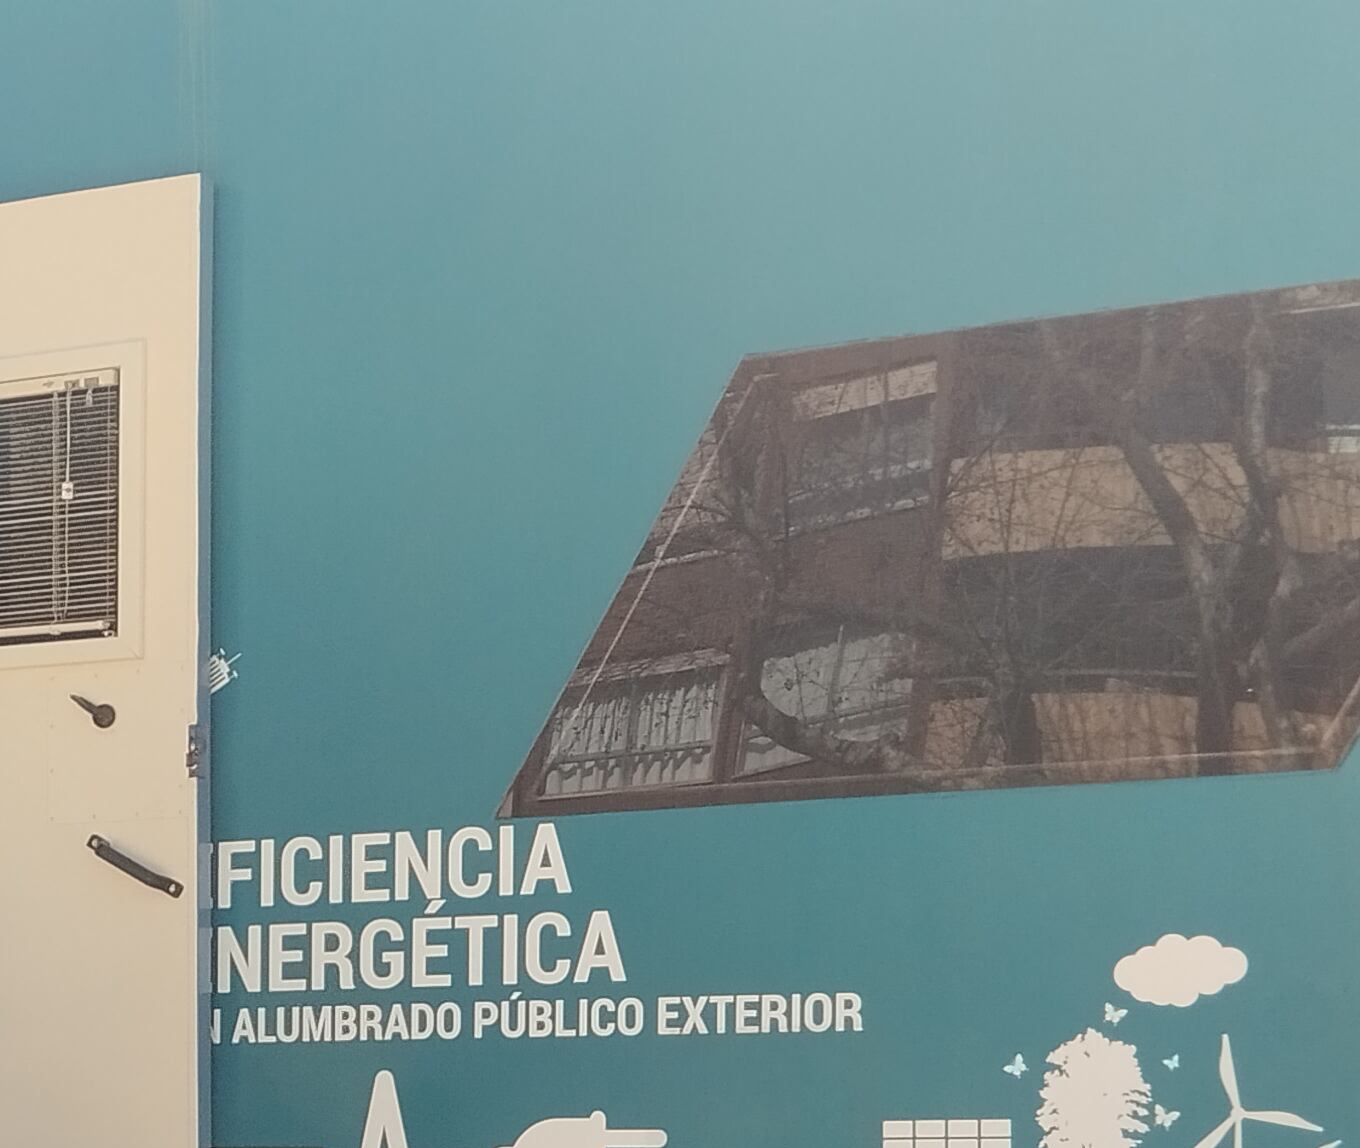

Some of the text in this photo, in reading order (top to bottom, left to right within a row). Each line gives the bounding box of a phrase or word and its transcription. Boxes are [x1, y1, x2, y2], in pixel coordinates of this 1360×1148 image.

[231, 1000, 463, 1044] ALUMBRADO
[473, 991, 645, 1040] PÚBLICO
[656, 991, 864, 1036] EXTERIOR
